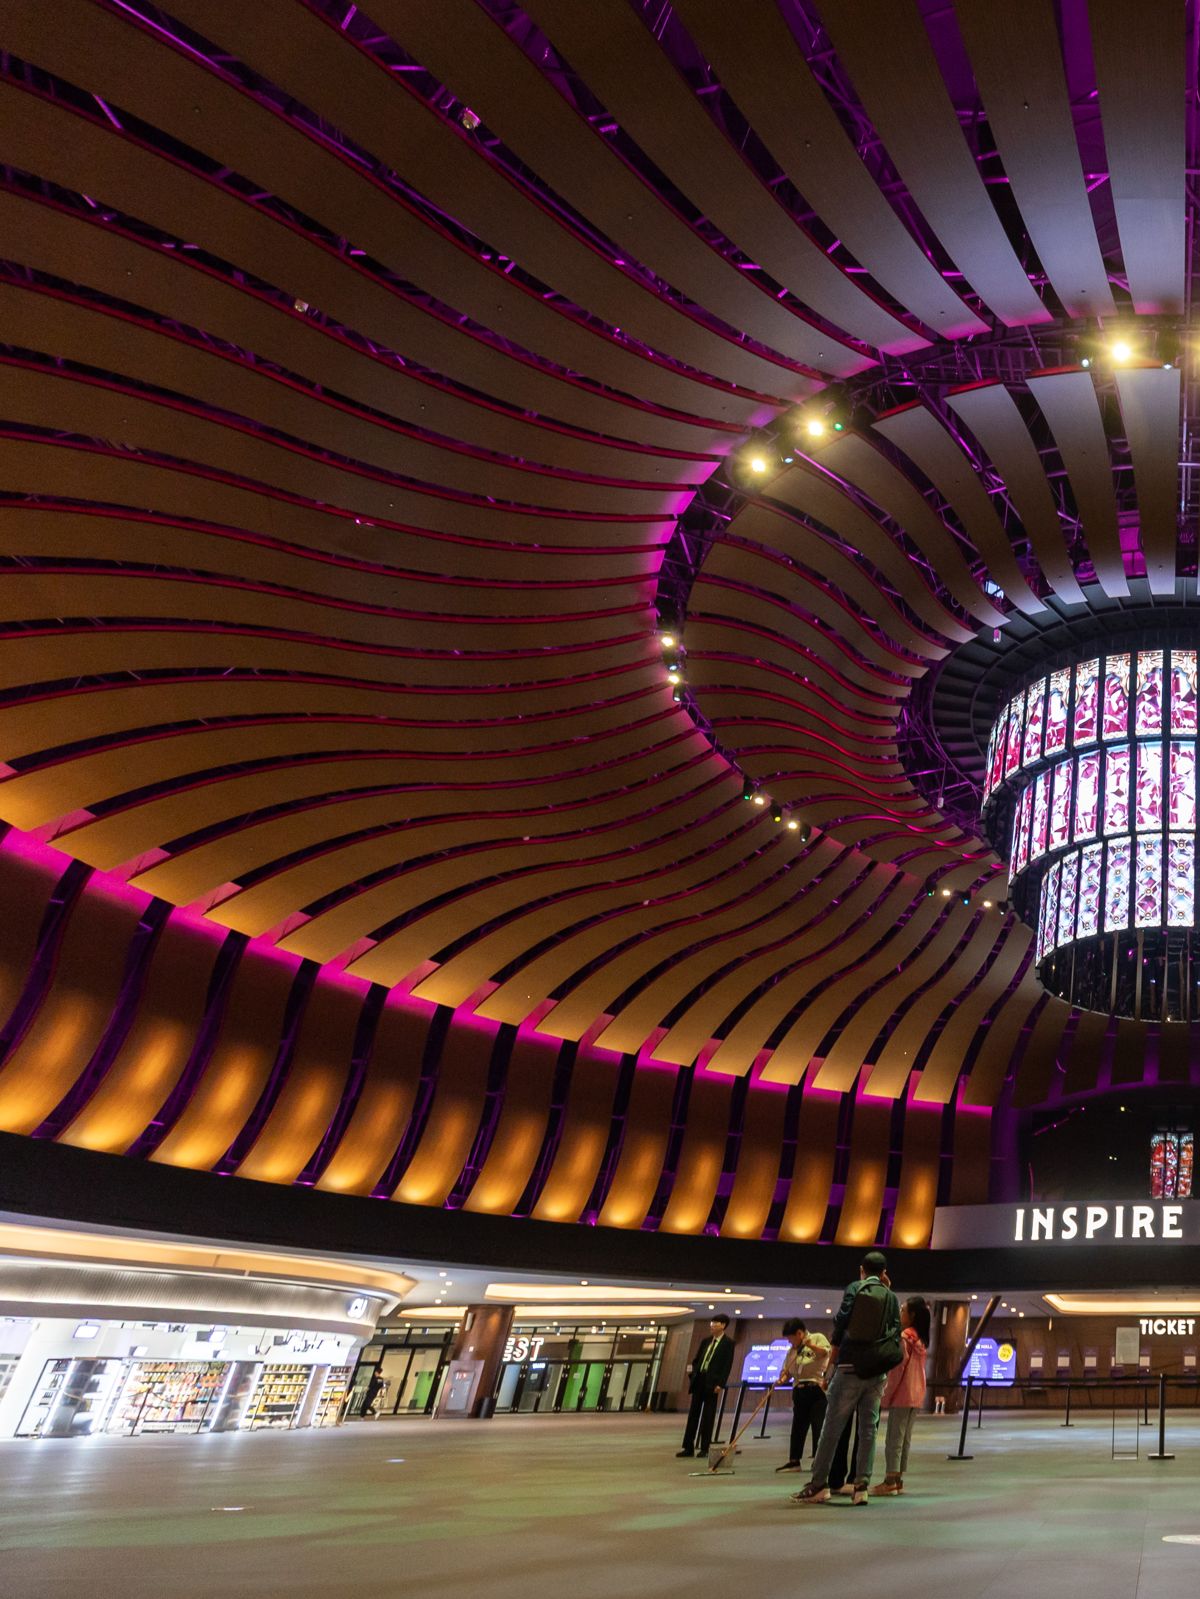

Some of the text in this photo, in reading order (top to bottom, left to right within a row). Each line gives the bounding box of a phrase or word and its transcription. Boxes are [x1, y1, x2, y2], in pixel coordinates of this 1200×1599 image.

[1015, 1206, 1182, 1240] INSPIRE
[1140, 1320, 1195, 1334] TICKET
[502, 1337, 545, 1362] EST
